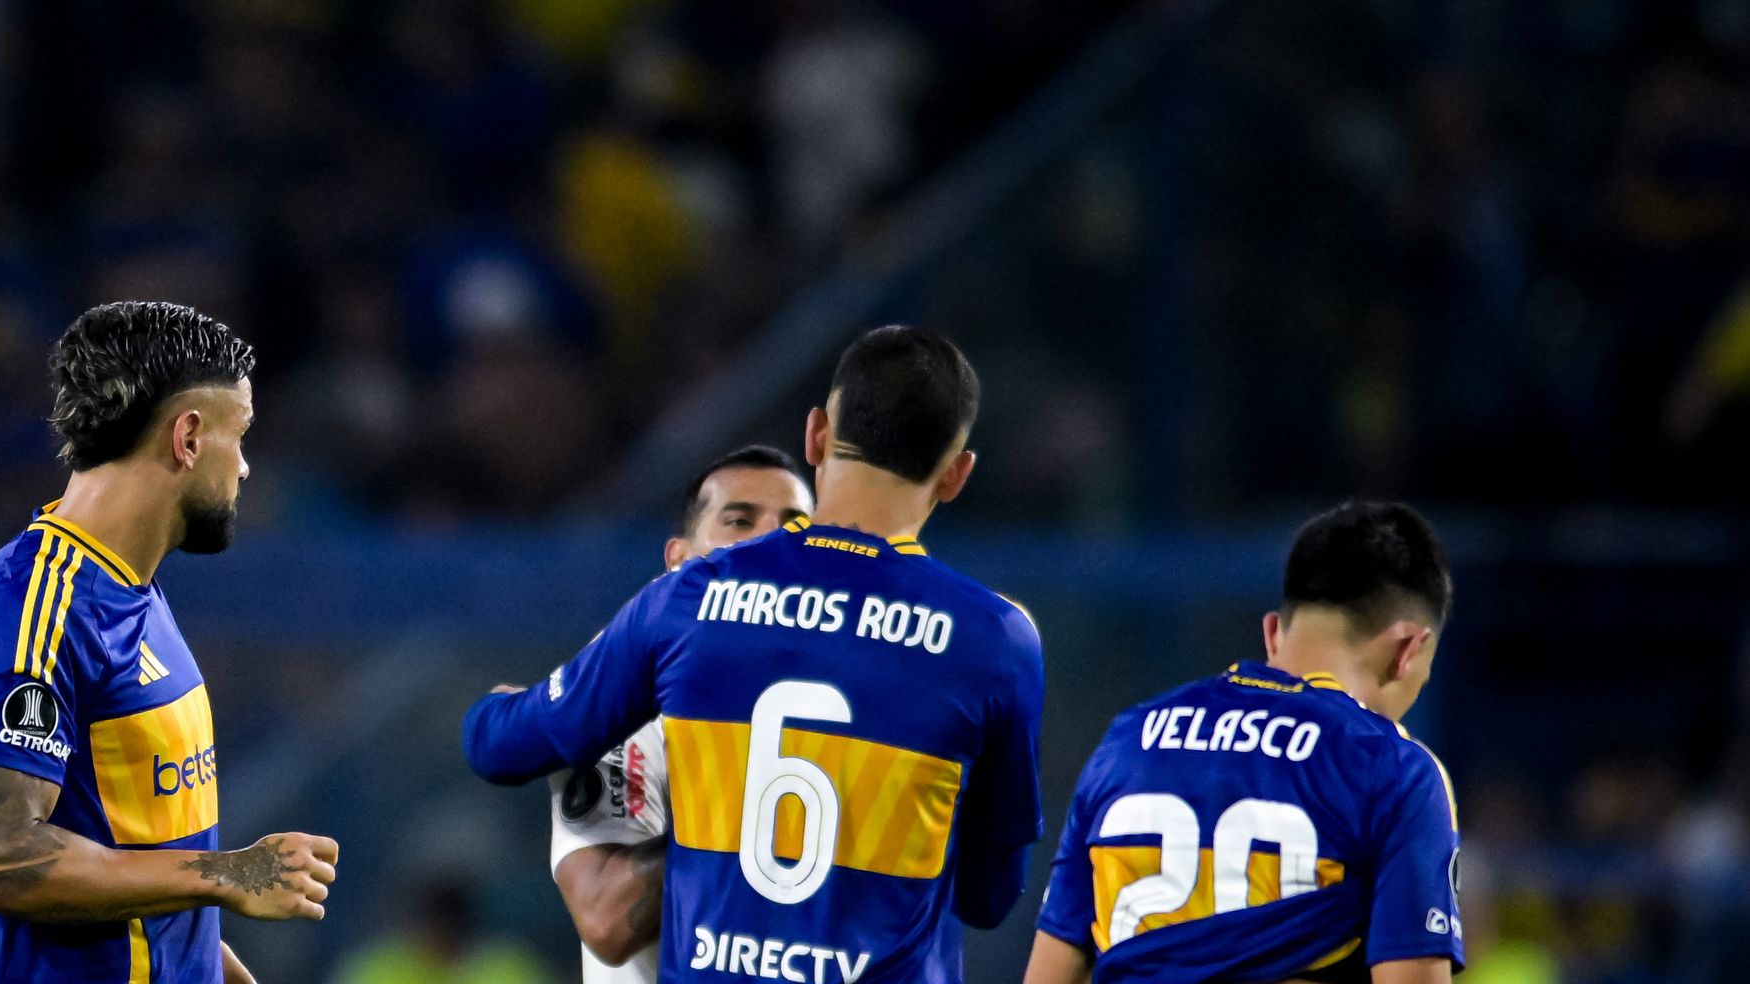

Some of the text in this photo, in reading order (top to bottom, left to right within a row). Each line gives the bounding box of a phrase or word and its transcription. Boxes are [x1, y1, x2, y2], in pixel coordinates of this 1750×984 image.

[803, 536, 880, 559] XENEIZE
[697, 580, 952, 655] MARCOS ROJO
[1141, 706, 1322, 762] VELASCO
[738, 681, 852, 905] 6
[1098, 792, 1319, 946] 20
